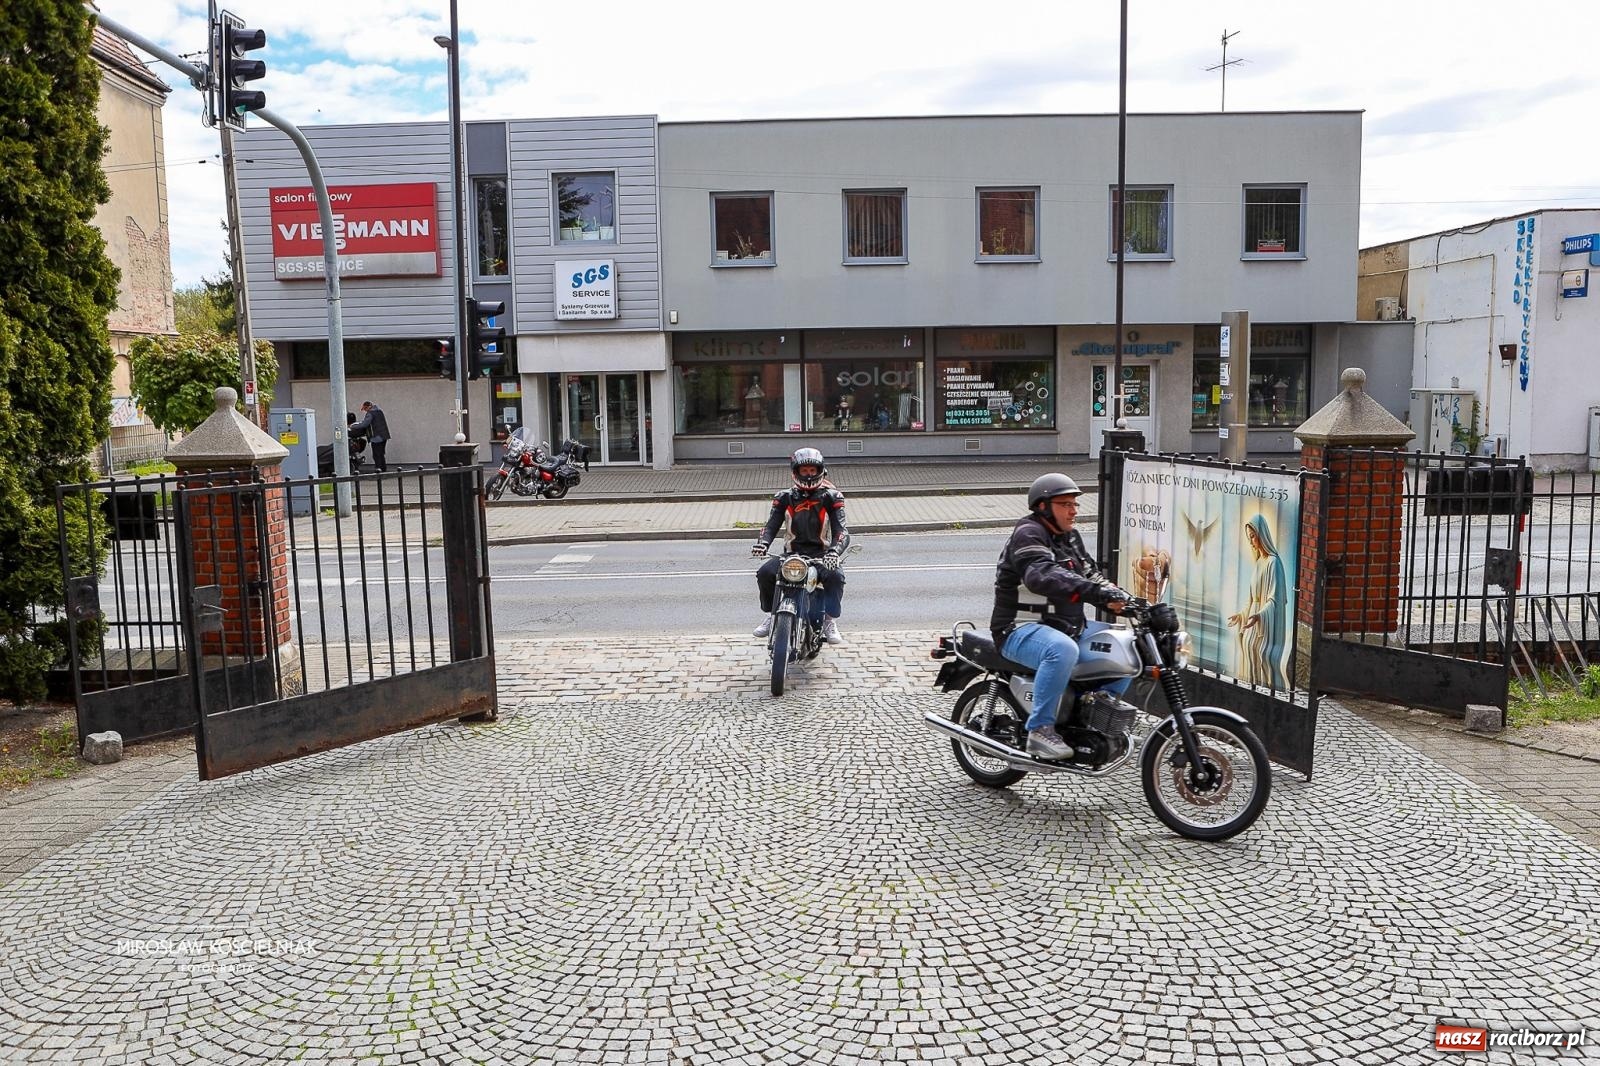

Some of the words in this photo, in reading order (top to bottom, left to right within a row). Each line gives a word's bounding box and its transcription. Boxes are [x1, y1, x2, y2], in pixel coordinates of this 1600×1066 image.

[274, 193, 305, 203] salon
[1565, 237, 1592, 252] PHILIPS
[571, 264, 610, 289] SGS
[572, 290, 611, 298] SERVICE
[838, 366, 914, 388] solar
[966, 381, 995, 389] DYWANÓW
[1173, 475, 1181, 486] W
[1183, 476, 1200, 490] DNI
[1202, 480, 1267, 499] POWSZEDNIE
[1269, 488, 1289, 501] 5:55
[1124, 517, 1137, 528] DO
[1139, 519, 1167, 532] NIEBA!
[1089, 641, 1112, 653] MZ
